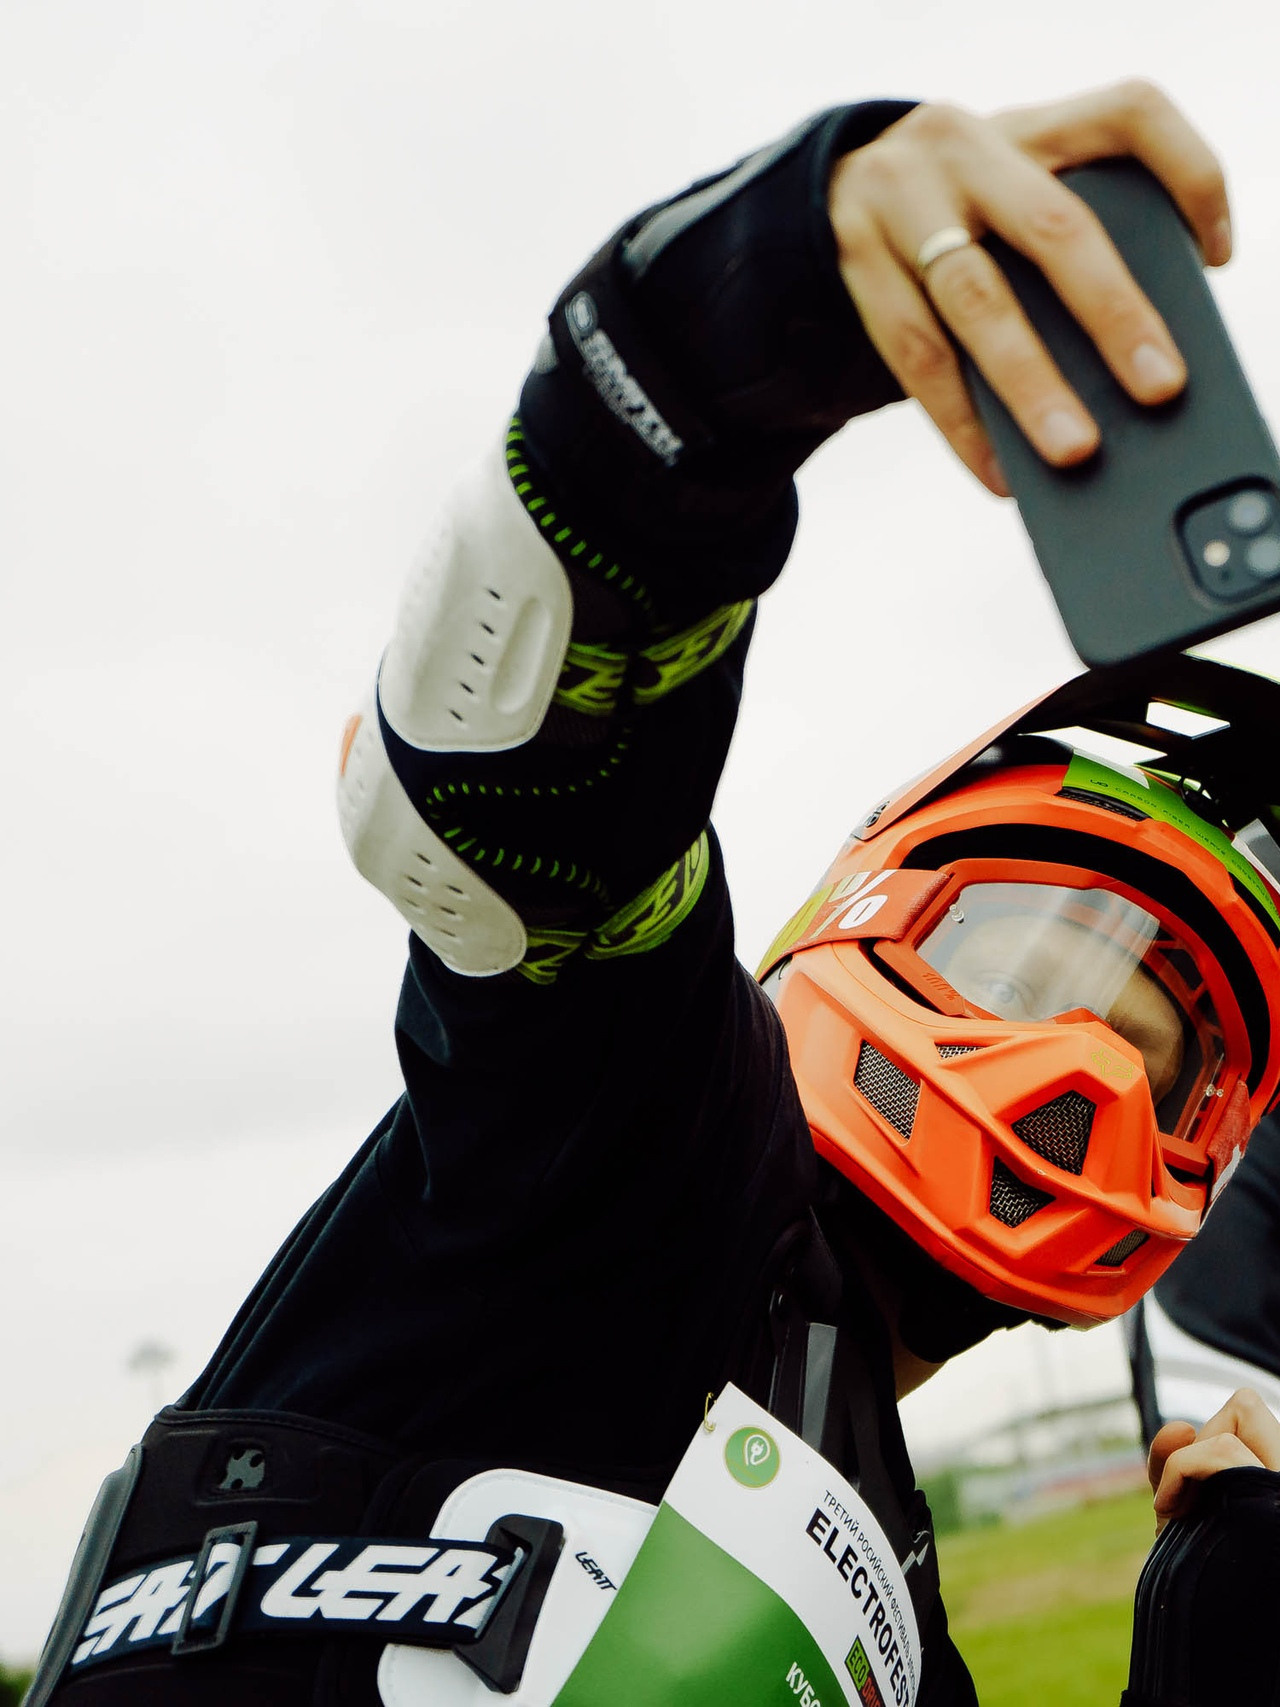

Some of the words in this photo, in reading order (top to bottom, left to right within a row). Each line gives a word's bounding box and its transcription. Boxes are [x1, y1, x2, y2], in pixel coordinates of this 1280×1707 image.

[823, 1490, 860, 1537] ТРЕТИЙ
[857, 1532, 894, 1600] РОСИЙСКИЙ
[575, 1551, 618, 1590] LEATT
[848, 1645, 867, 1684] ECO
